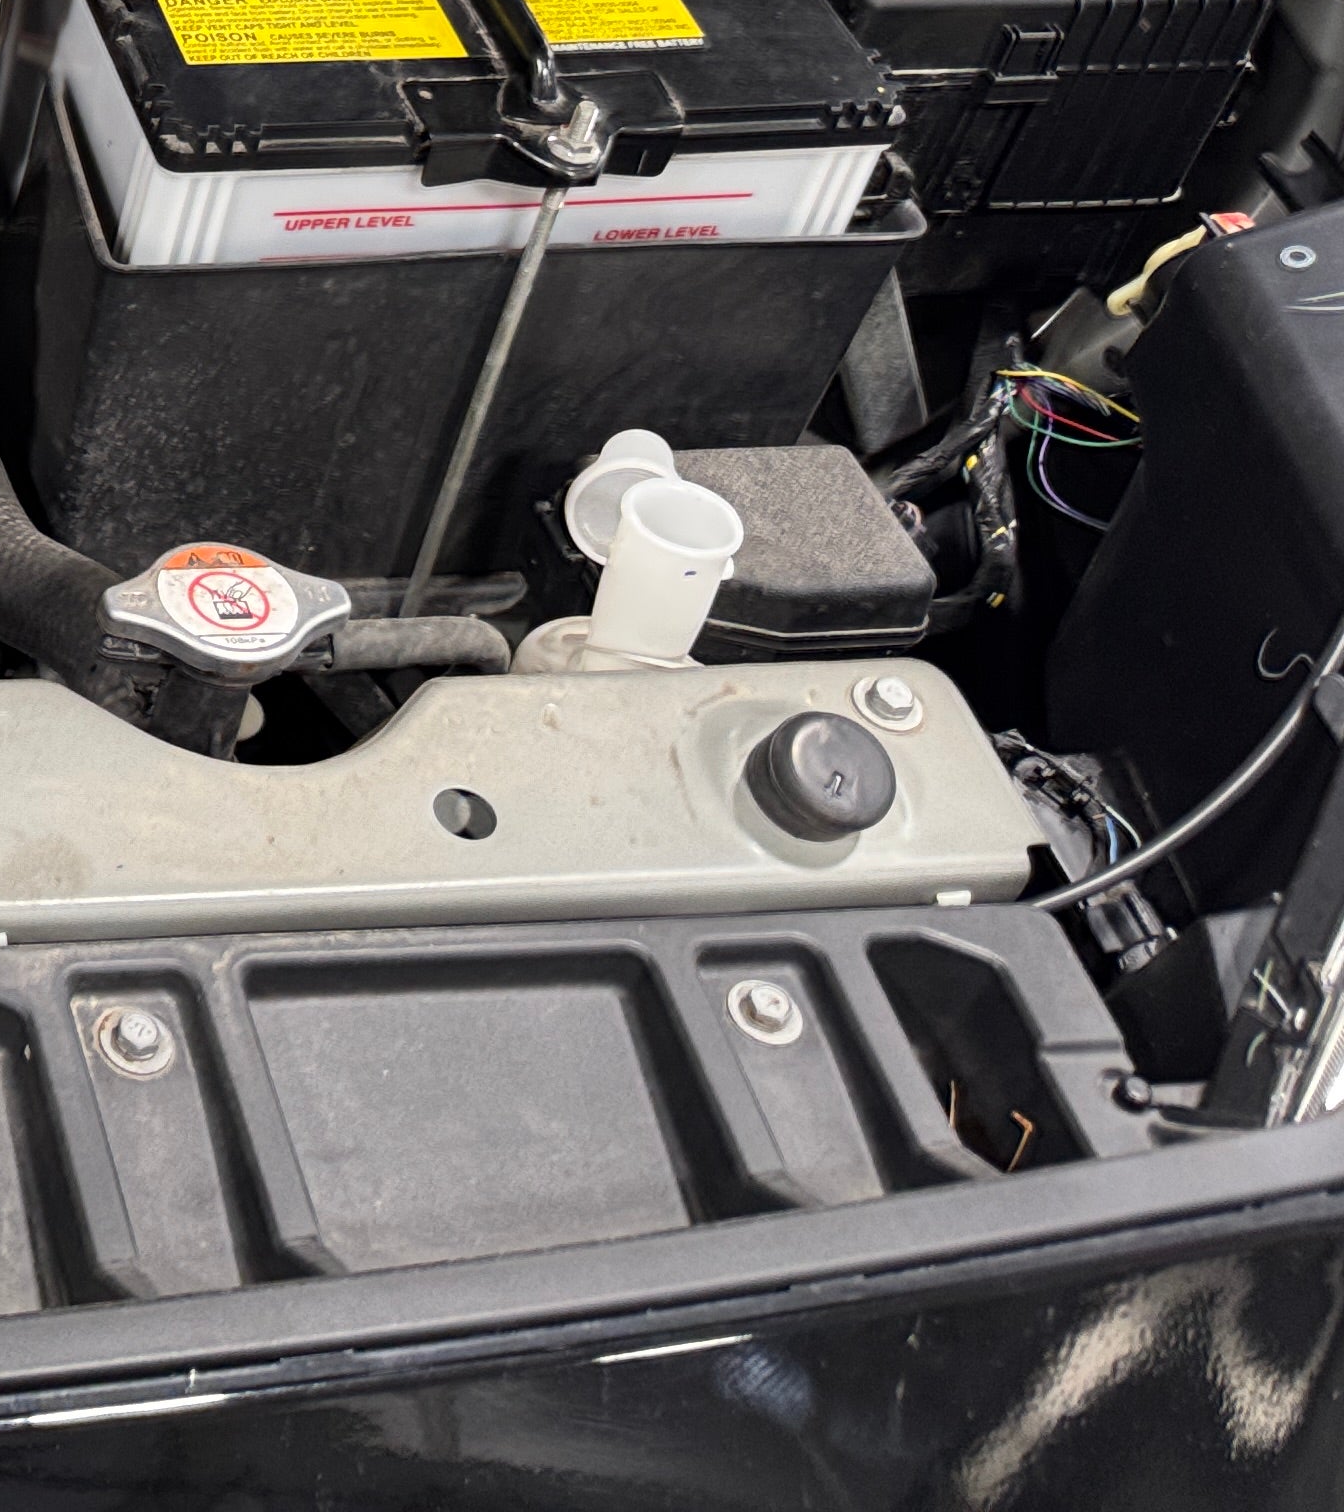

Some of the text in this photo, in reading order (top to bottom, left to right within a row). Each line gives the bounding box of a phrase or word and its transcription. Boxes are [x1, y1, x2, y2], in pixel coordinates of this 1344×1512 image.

[180, 32, 258, 44] POISON
[285, 215, 415, 231] UPPER LEVEL
[593, 225, 720, 241] LOWER LEVEL
